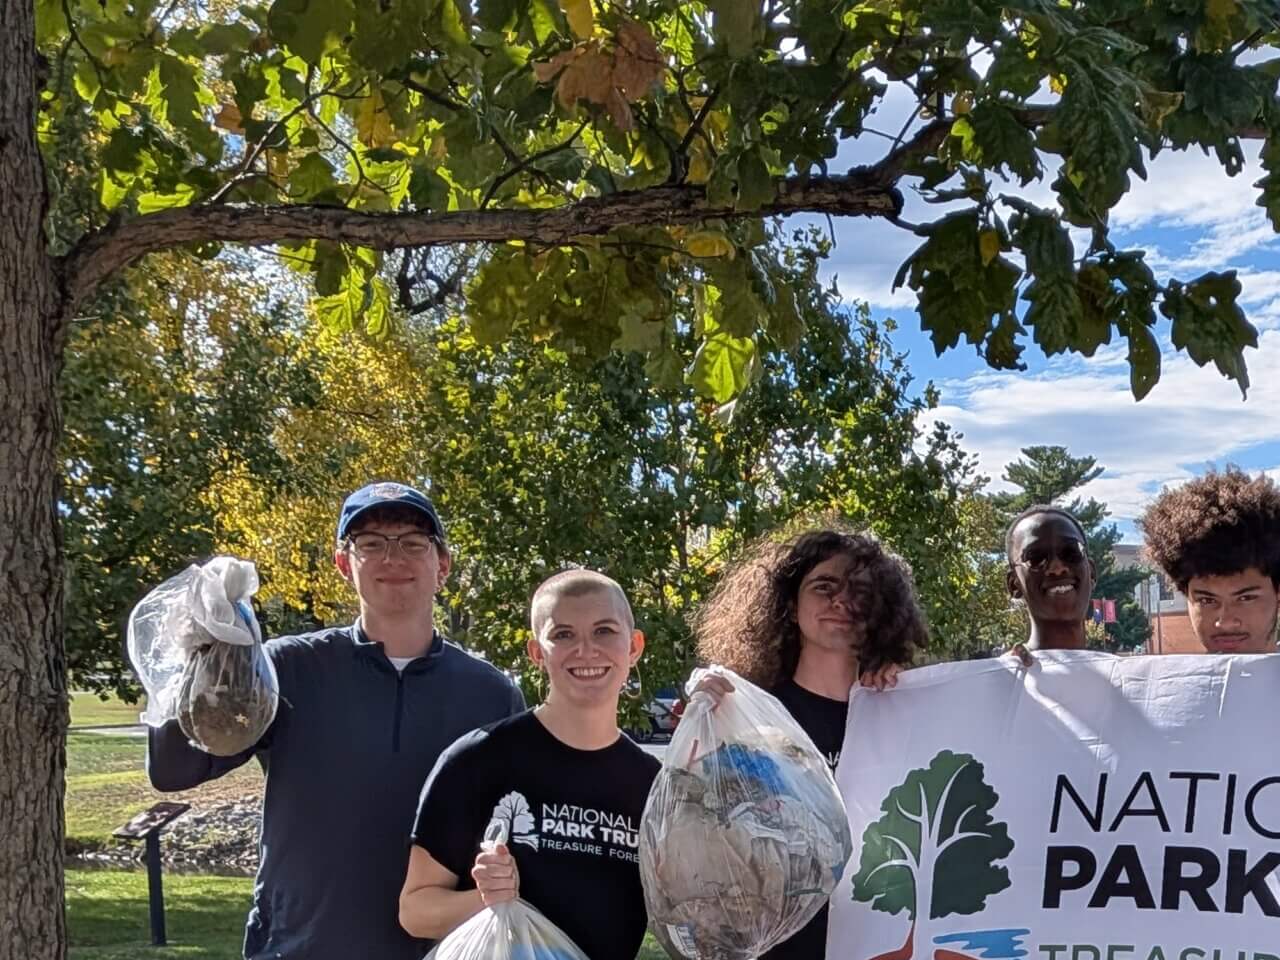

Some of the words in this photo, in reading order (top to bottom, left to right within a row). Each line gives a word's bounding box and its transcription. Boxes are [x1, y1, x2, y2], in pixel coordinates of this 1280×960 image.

[542, 803, 638, 833] NATIONAL
[542, 818, 595, 840] PARK
[600, 827, 640, 848] TRU
[541, 838, 602, 856] TREASURE
[609, 847, 640, 864] FORE
